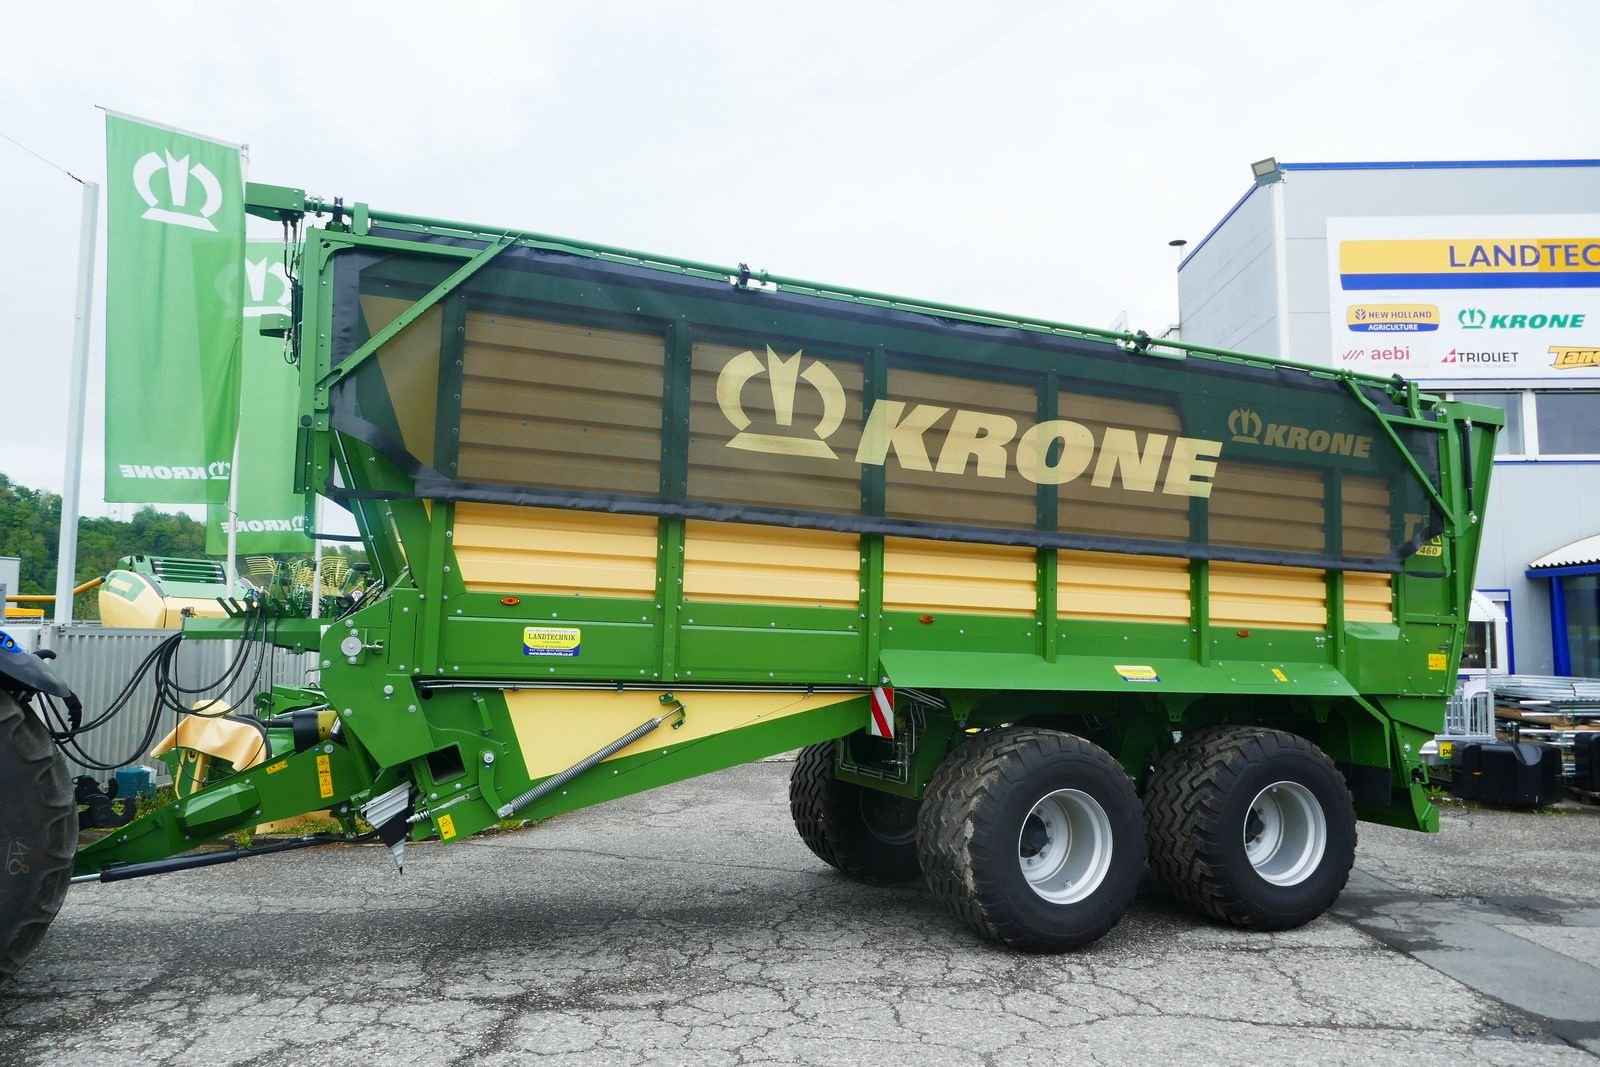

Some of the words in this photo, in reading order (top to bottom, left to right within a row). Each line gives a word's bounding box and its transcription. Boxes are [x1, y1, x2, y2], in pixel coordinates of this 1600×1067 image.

[1449, 244, 1600, 267] LANDTEC
[1369, 311, 1389, 319] NEW
[1368, 323, 1418, 331] AGRICULTURE
[1490, 314, 1586, 329] KRONE
[1371, 346, 1409, 360] aebi
[1457, 352, 1519, 363] TRIOLIET
[1264, 423, 1374, 458] KRONE
[855, 398, 1222, 498] KRONE
[1419, 547, 1438, 555] 460
[528, 633, 576, 641] LANDTECHNIK
